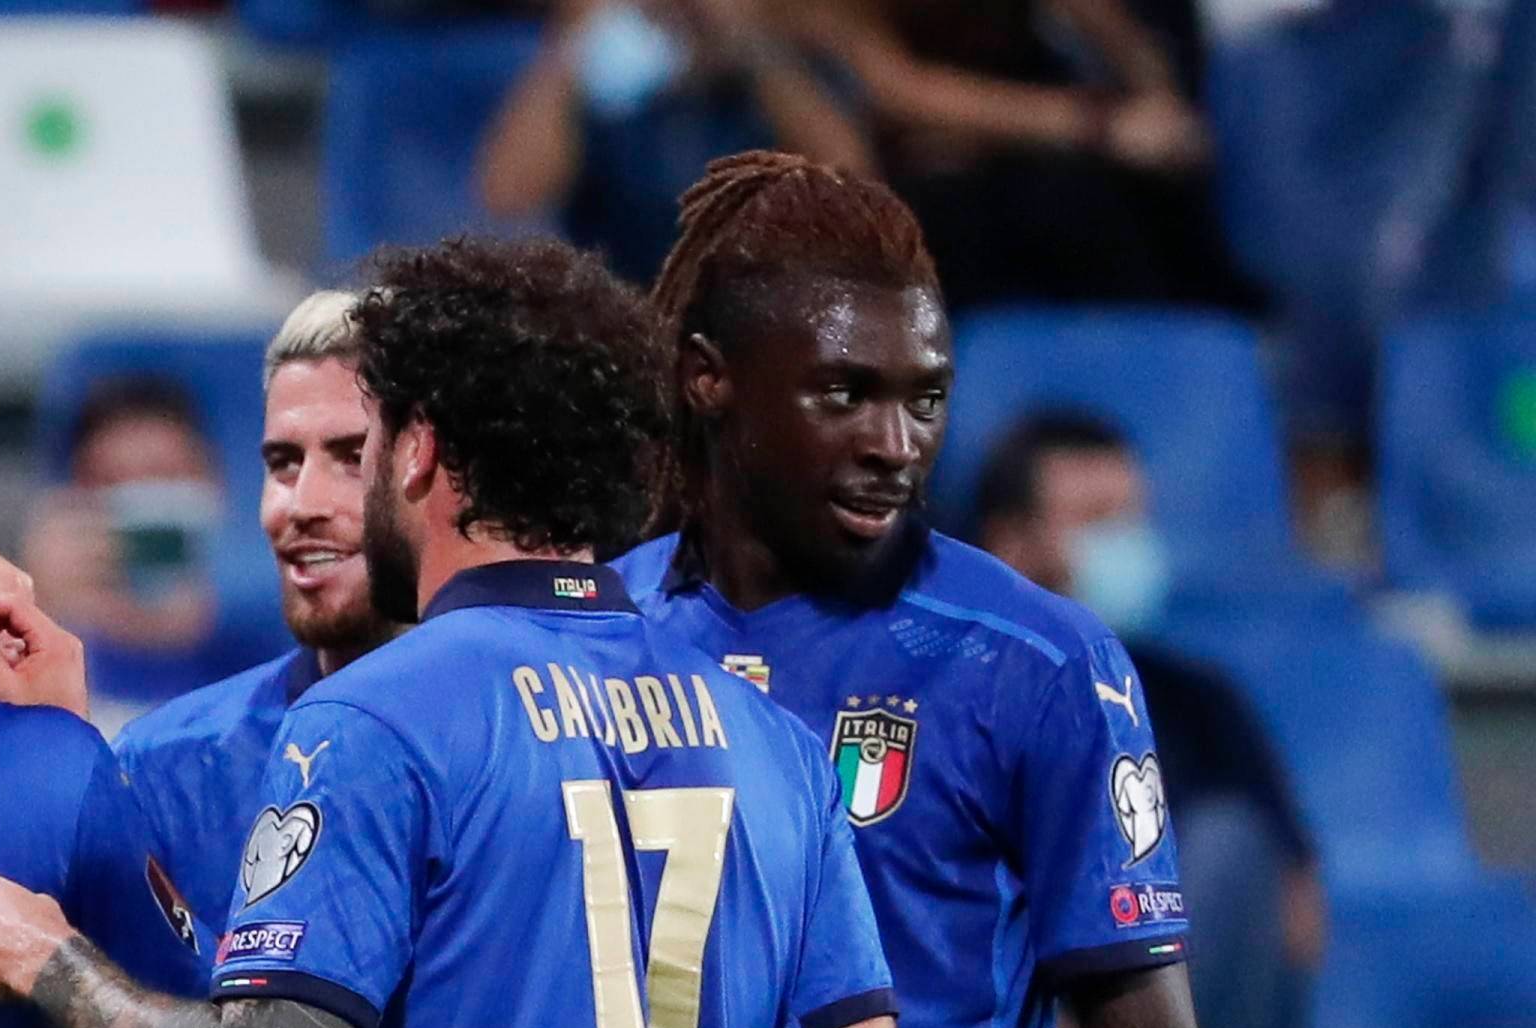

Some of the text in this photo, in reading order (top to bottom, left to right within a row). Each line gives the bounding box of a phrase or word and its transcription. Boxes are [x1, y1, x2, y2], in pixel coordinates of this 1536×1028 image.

[554, 577, 597, 593] ITALIA
[844, 720, 909, 742] ITALIA
[231, 929, 304, 952] RESPECT
